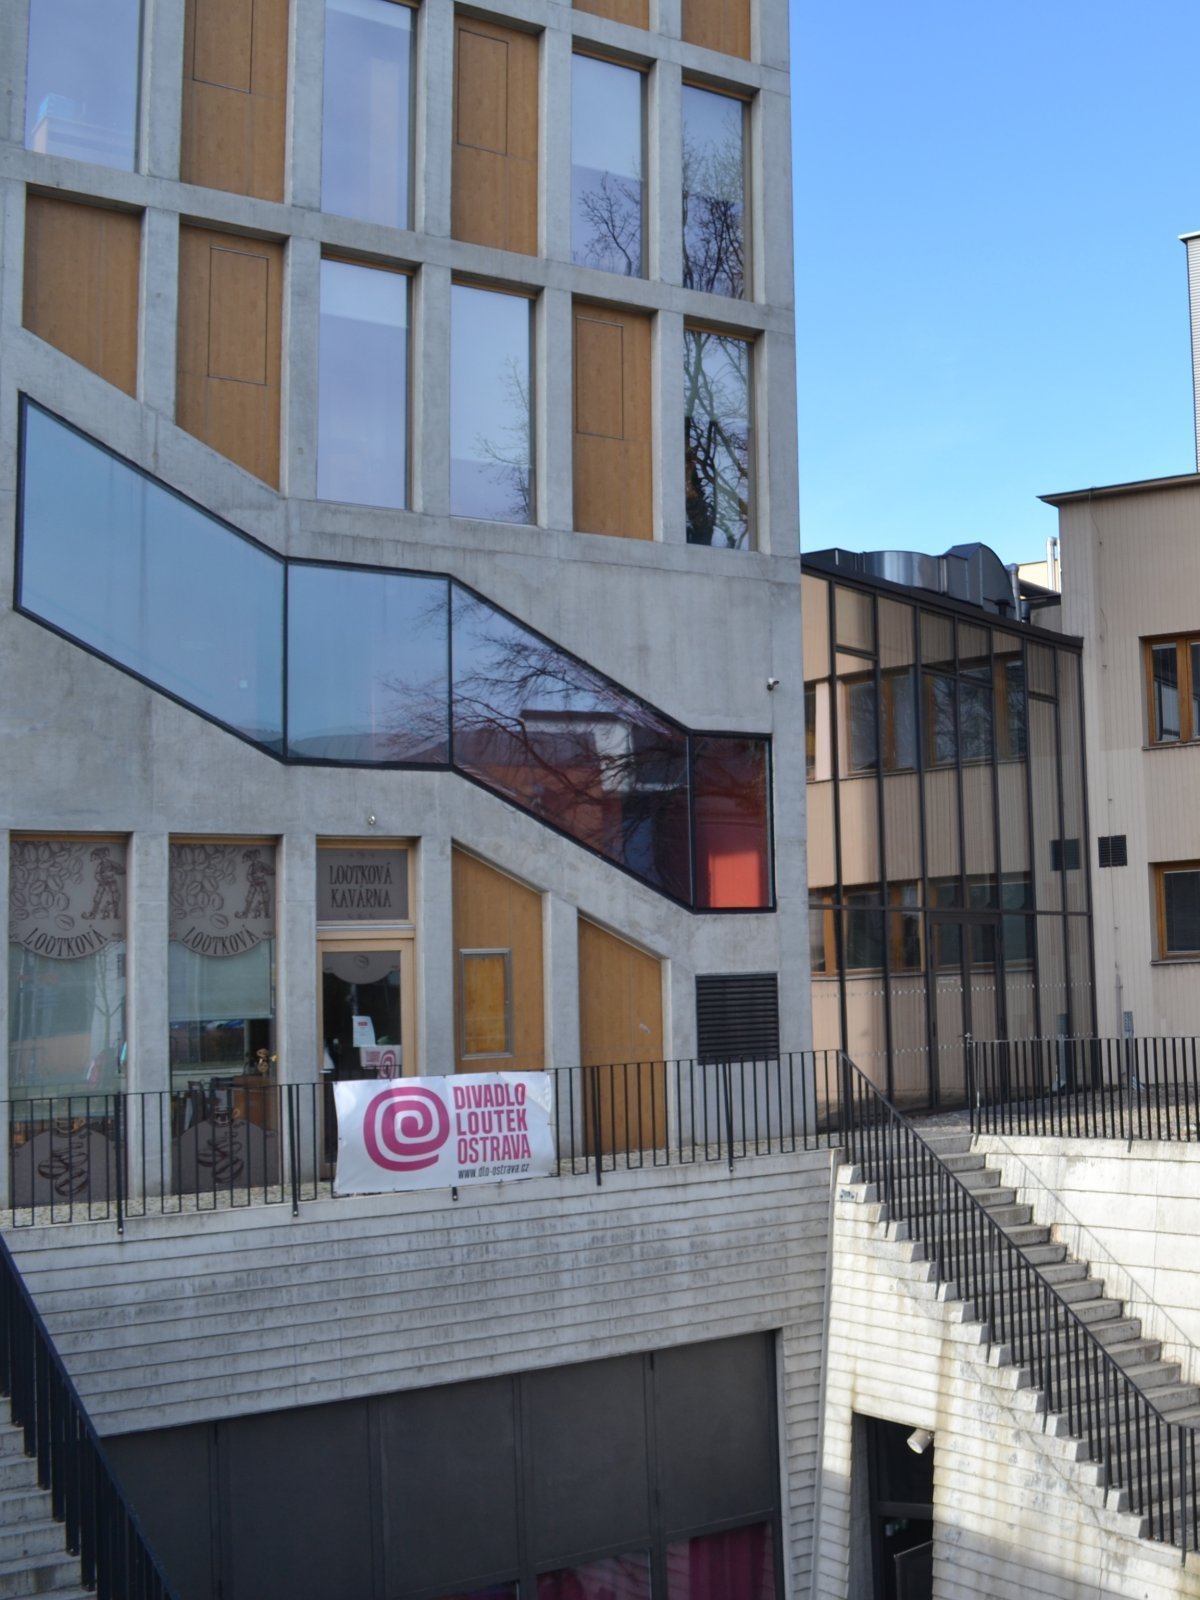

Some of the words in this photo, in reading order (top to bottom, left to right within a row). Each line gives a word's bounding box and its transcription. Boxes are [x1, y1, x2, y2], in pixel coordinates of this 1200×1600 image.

[328, 861, 393, 885] LOUTKOVÁ
[330, 885, 392, 908] KAVÁRNA
[452, 1083, 526, 1110] DIVADLO
[456, 1108, 528, 1136] LOUTEK
[457, 1133, 532, 1165] OSTRAVA
[457, 1163, 531, 1180] www.dlo-ostrava.cz
